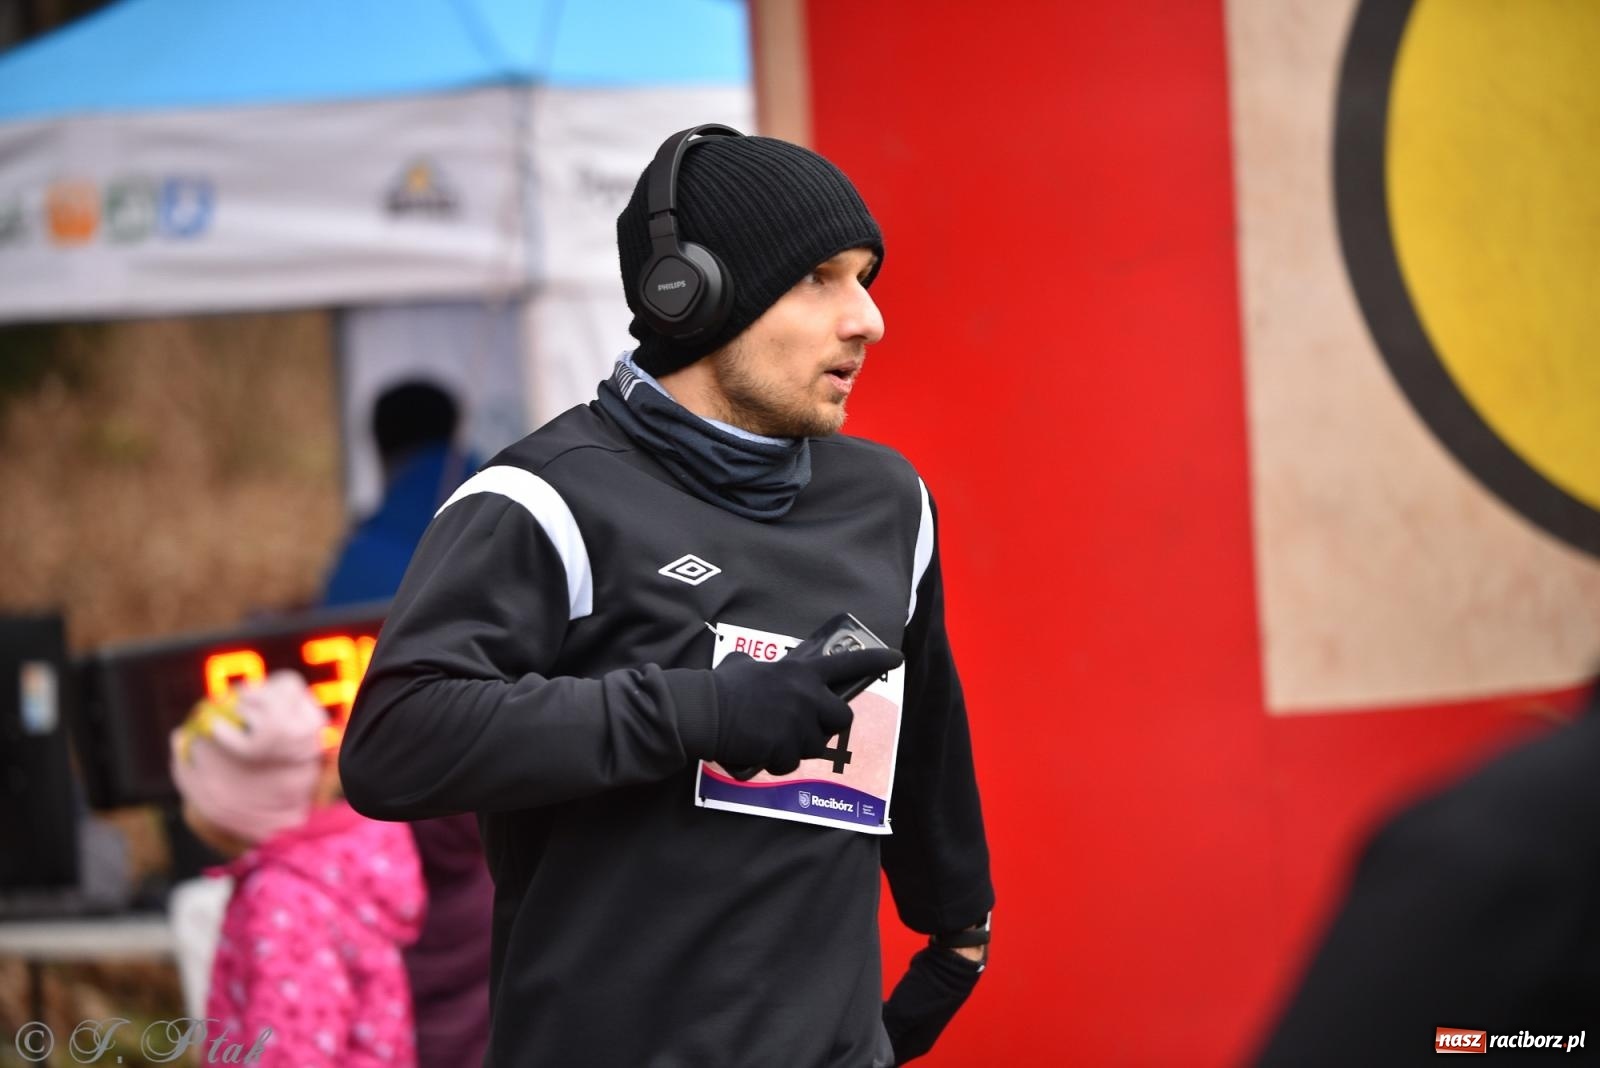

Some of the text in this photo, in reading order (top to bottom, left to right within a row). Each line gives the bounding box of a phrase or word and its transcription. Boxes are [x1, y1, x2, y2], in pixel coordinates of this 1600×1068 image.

[657, 280, 687, 291] PHILIPS
[735, 637, 778, 660] BIEG
[811, 795, 854, 812] Racibórz
